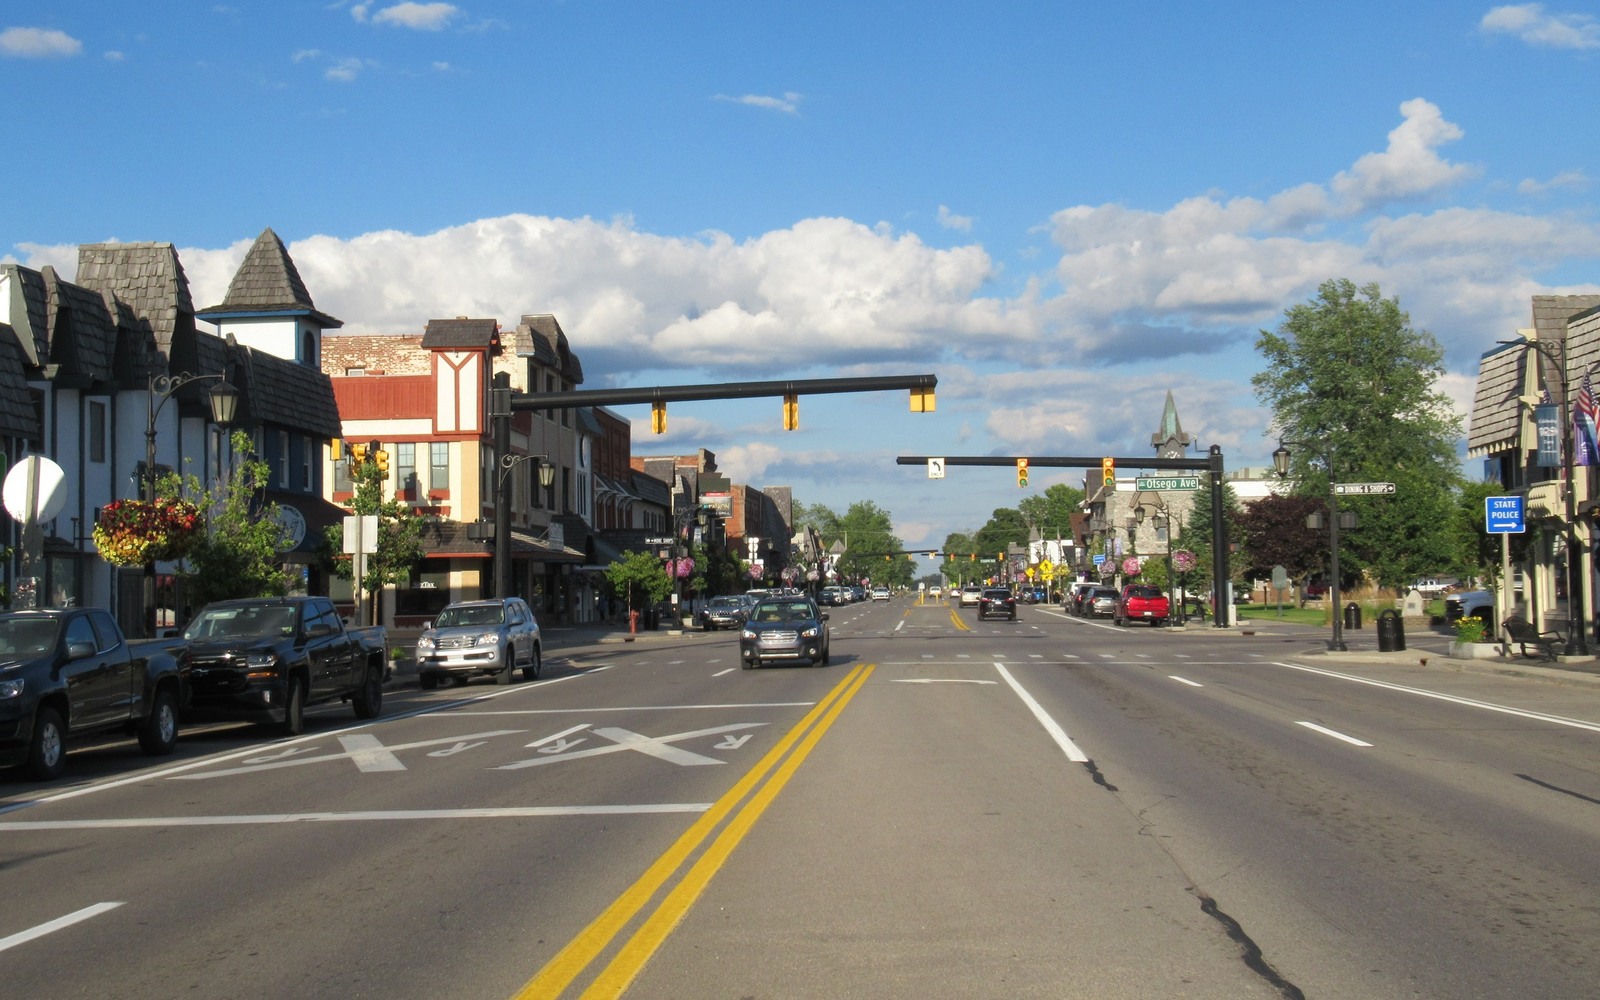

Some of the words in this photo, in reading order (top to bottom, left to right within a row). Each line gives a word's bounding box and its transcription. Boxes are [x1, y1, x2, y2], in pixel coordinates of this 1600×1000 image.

[1146, 479, 1177, 489] Otsego
[1180, 478, 1196, 488] Ave
[1344, 485, 1363, 493] DINING
[1364, 485, 1369, 493] &
[1369, 485, 1388, 493] SHOPS
[1494, 500, 1516, 508] STATE
[283, 505, 300, 518] BIRCH
[1491, 511, 1519, 519] POLICE
